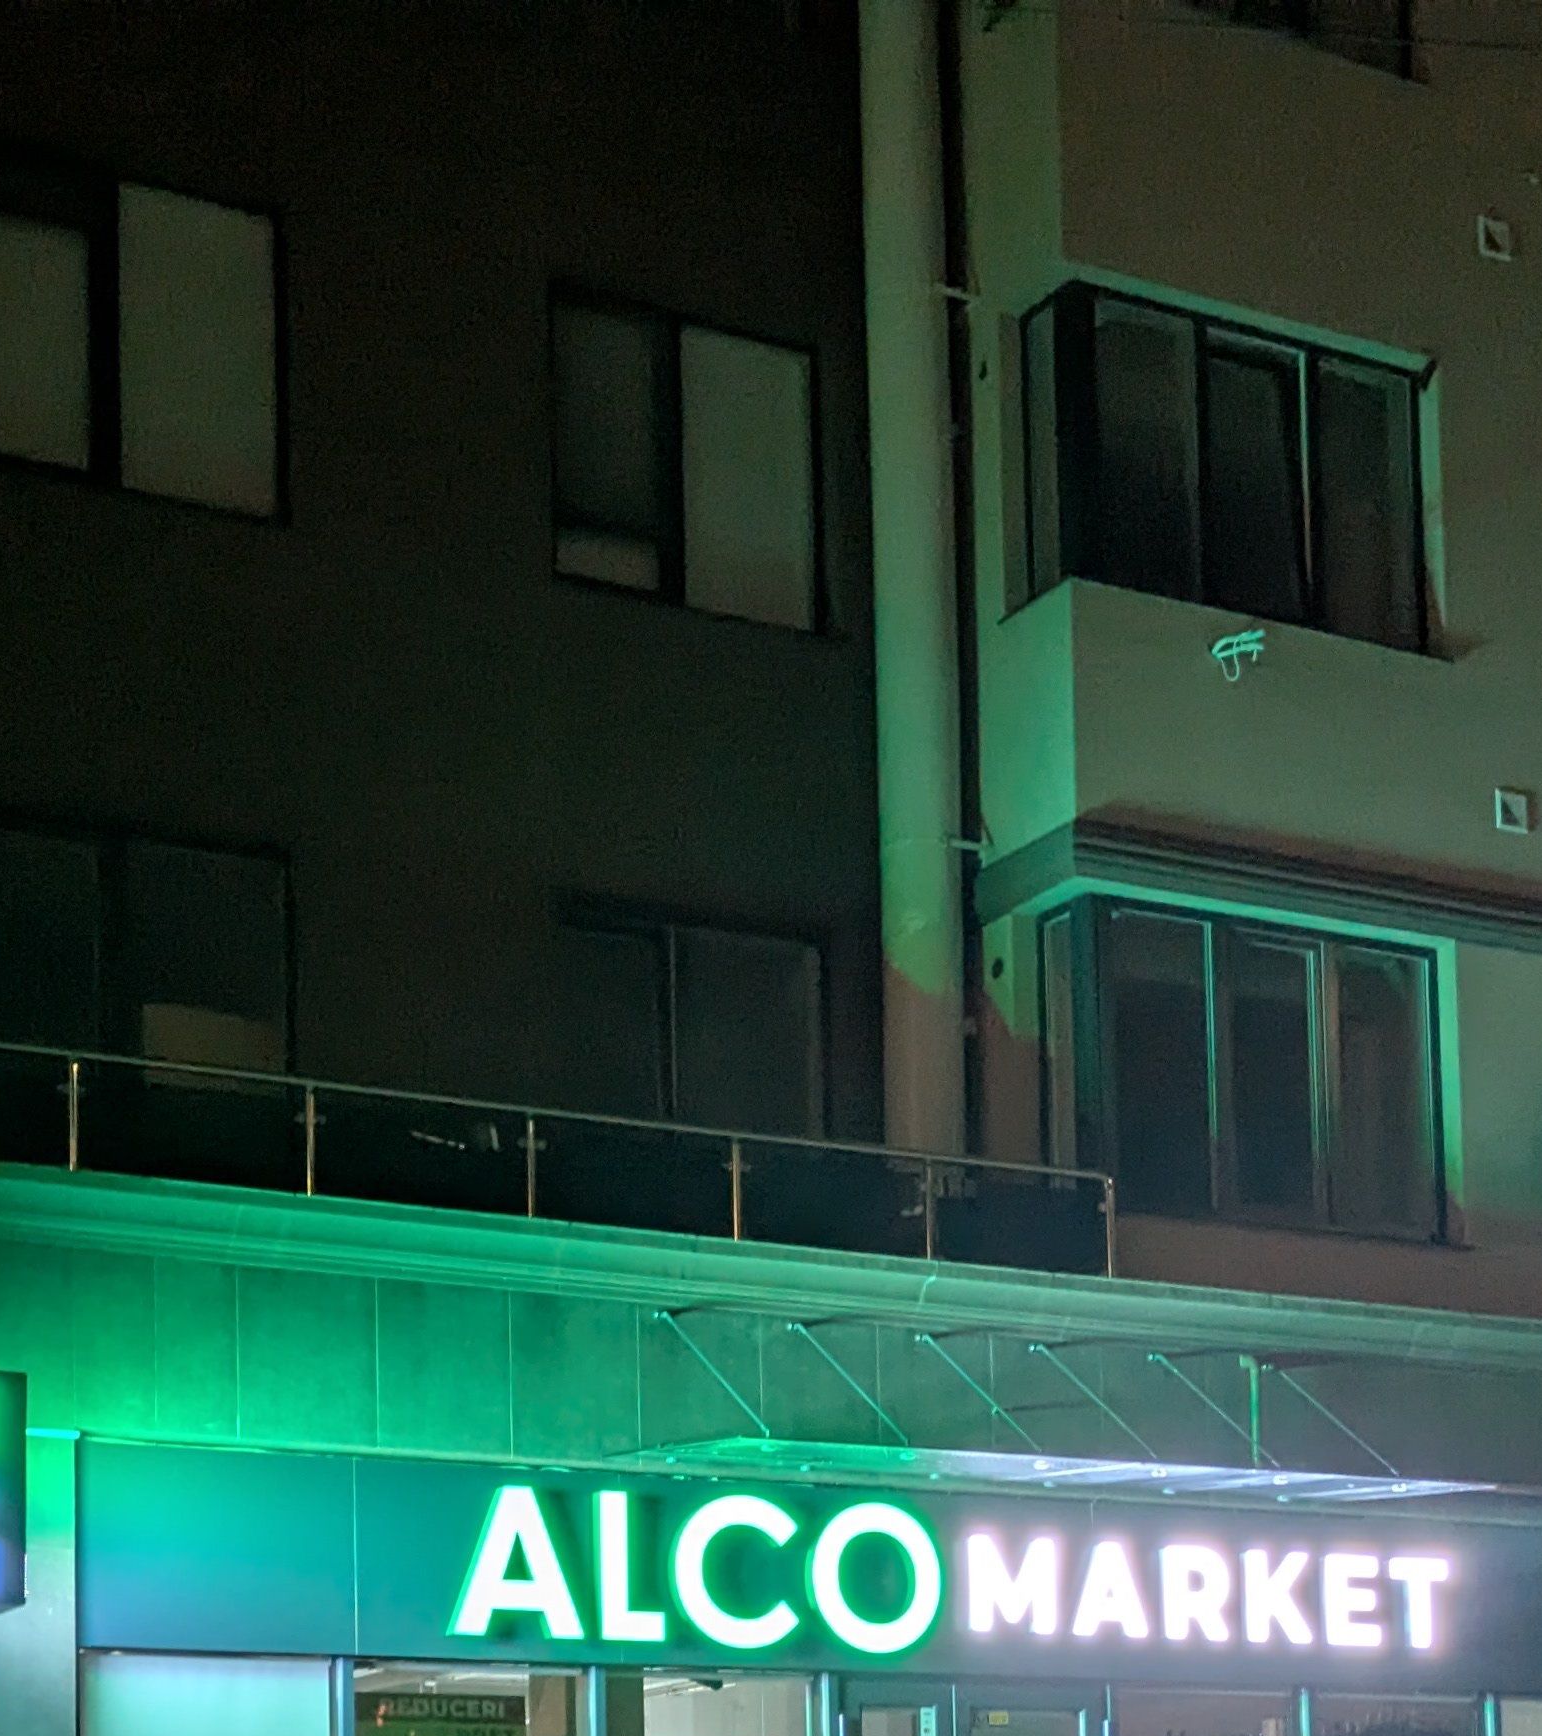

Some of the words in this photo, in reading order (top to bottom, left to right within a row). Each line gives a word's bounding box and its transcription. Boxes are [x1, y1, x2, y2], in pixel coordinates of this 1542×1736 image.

[446, 1485, 941, 1653] ALCO
[966, 1533, 1449, 1650] MARKET
[379, 1697, 506, 1719] REDUCERI
